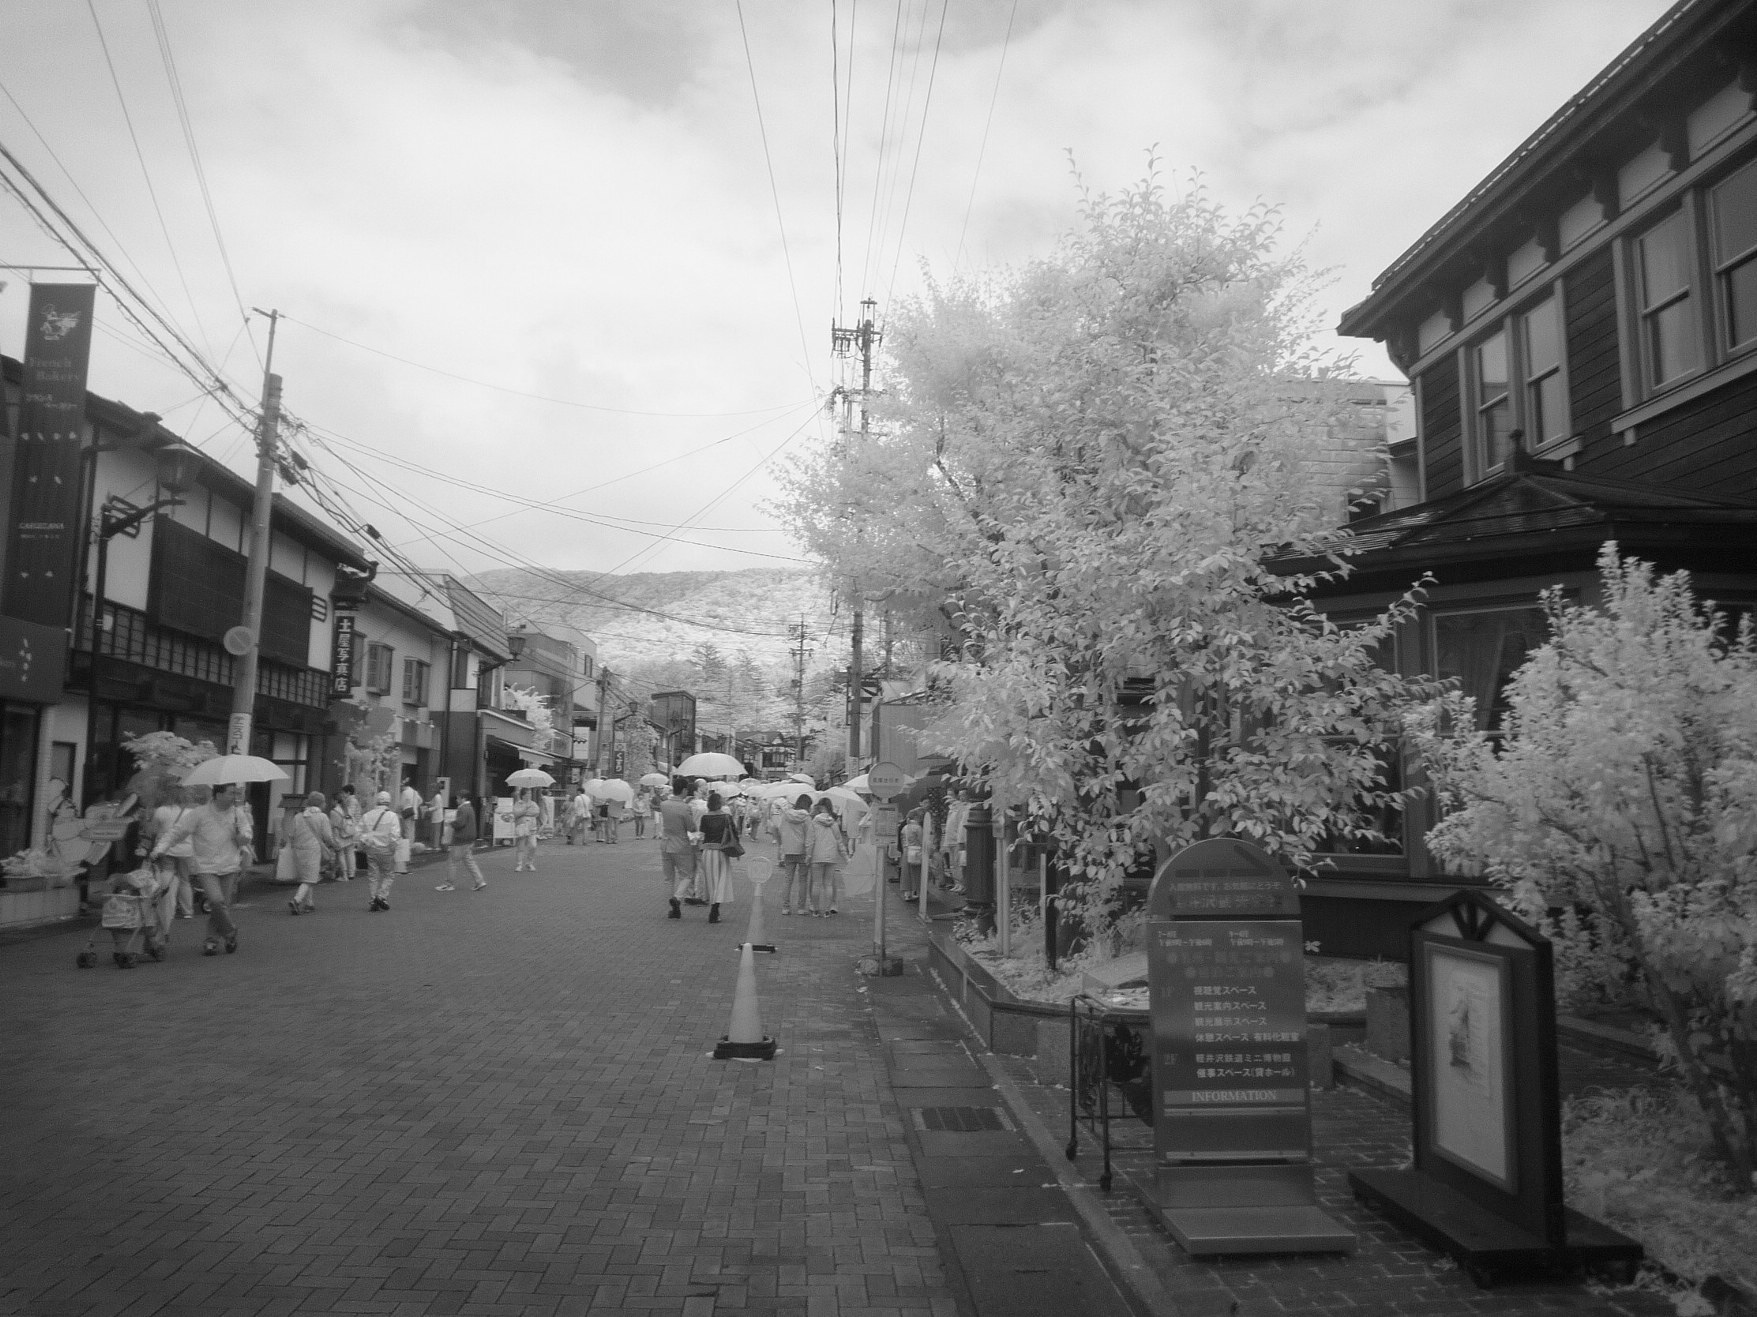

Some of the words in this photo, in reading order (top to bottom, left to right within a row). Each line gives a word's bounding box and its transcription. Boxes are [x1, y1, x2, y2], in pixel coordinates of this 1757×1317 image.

[334, 618, 351, 692] 土屋写真店
[1193, 985, 1257, 996] 視聴覚スペース
[1194, 1001, 1268, 1012] 観光案内スペース
[1194, 1017, 1268, 1028] 観光展示スペース
[1195, 1032, 1250, 1043] 休憩スペース
[1195, 1053, 1292, 1064] 軽井沢鉄道ミニ博物館
[1191, 1090, 1278, 1102] INFORMATION
